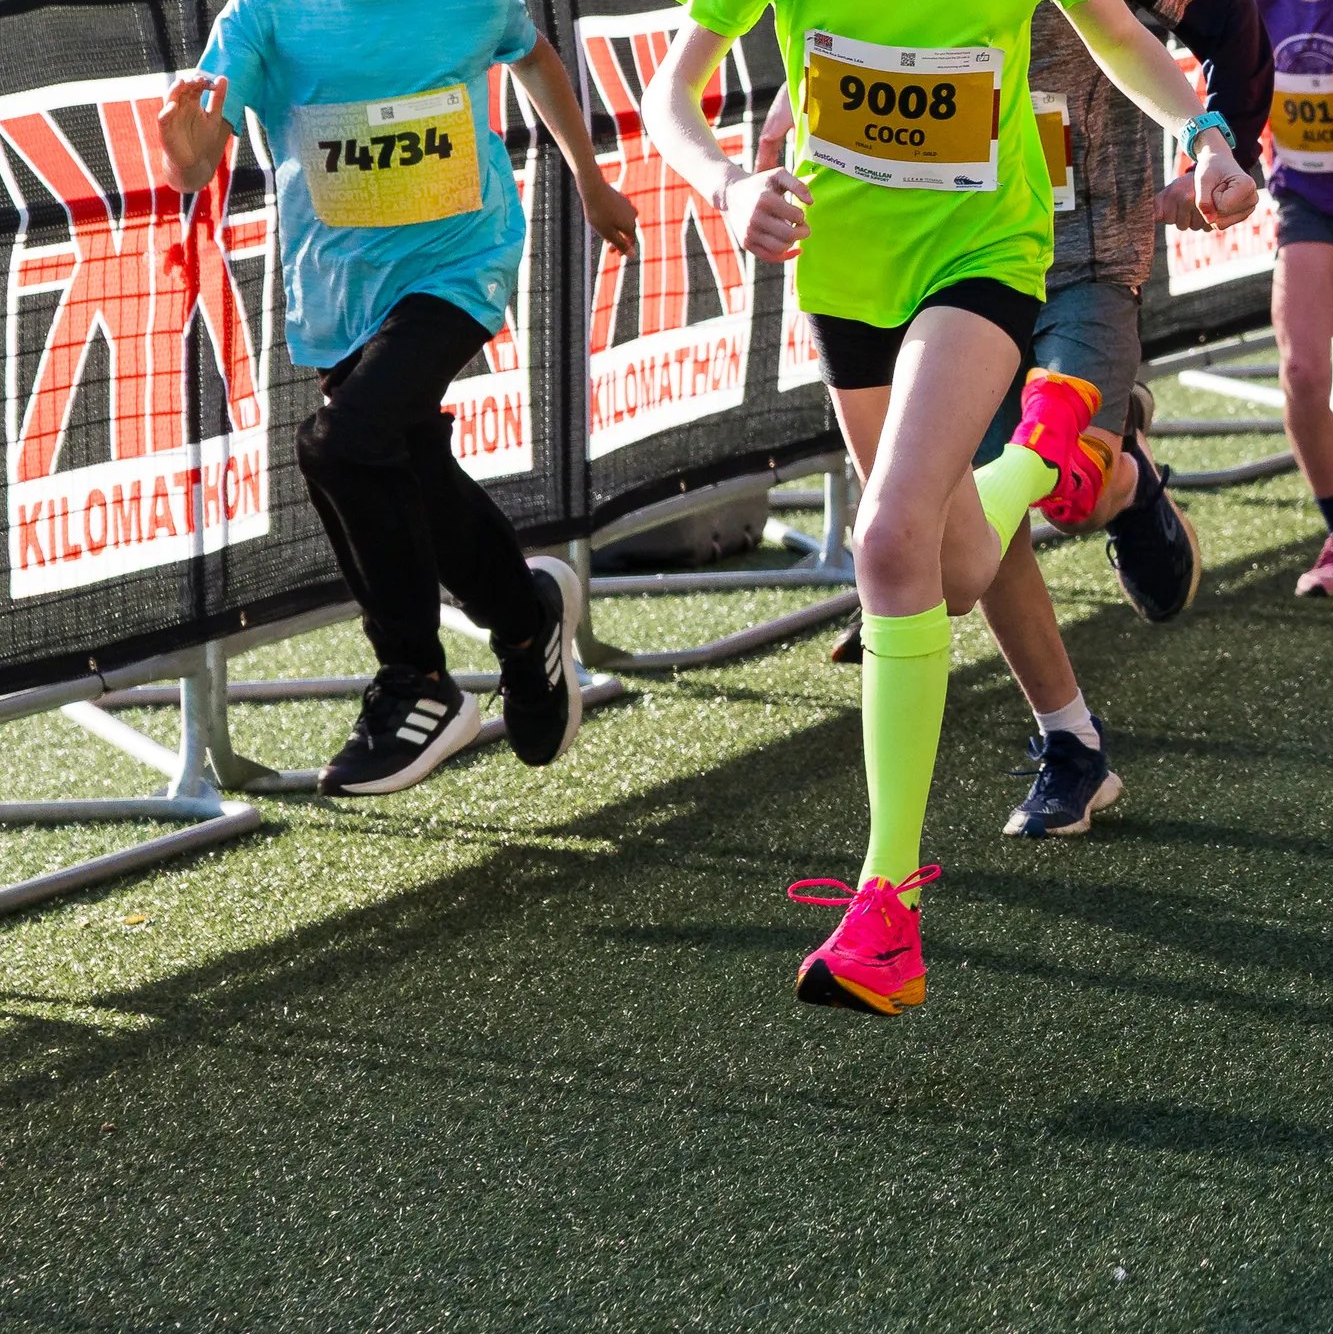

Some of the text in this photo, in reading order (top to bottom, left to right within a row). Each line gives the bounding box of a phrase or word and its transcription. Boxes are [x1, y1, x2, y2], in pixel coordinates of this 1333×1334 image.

[840, 75, 957, 120] 9008
[318, 127, 453, 173] 74734
[864, 123, 925, 146] COCO
[855, 166, 892, 179] MACMILLAN
[590, 330, 743, 434] KILOMATHON
[18, 449, 261, 571] KILOMATHON
